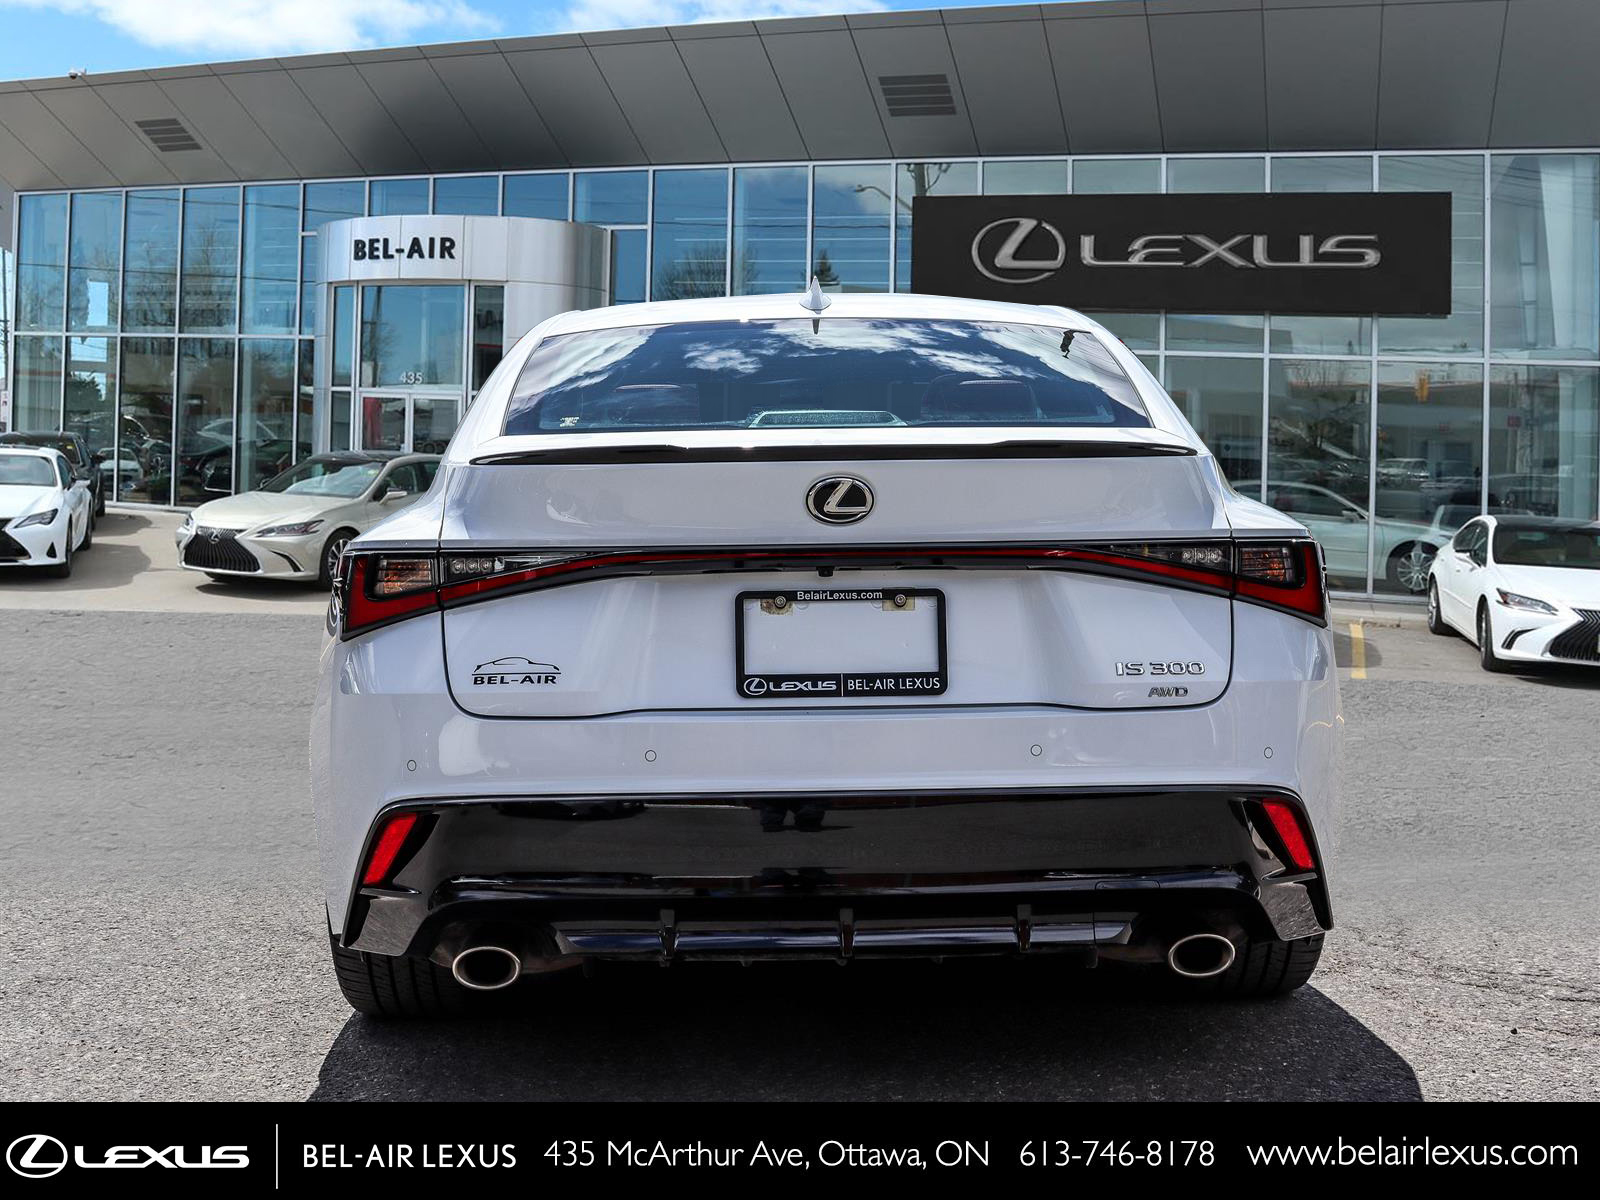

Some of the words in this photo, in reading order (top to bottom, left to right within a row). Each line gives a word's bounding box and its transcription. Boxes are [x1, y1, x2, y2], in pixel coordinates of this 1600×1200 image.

[353, 237, 456, 261] BEL-AIR
[1080, 234, 1382, 269] LEXUS
[400, 371, 424, 385] 435
[796, 590, 883, 601] BelairLexus.com
[1115, 661, 1145, 676] IS
[1149, 661, 1206, 676] 300
[473, 675, 557, 685] BEL-AIR
[769, 680, 837, 692] LEXUS
[847, 678, 896, 691] BEL-AIR
[899, 677, 941, 690] LEXUS
[1148, 686, 1189, 697] AWD
